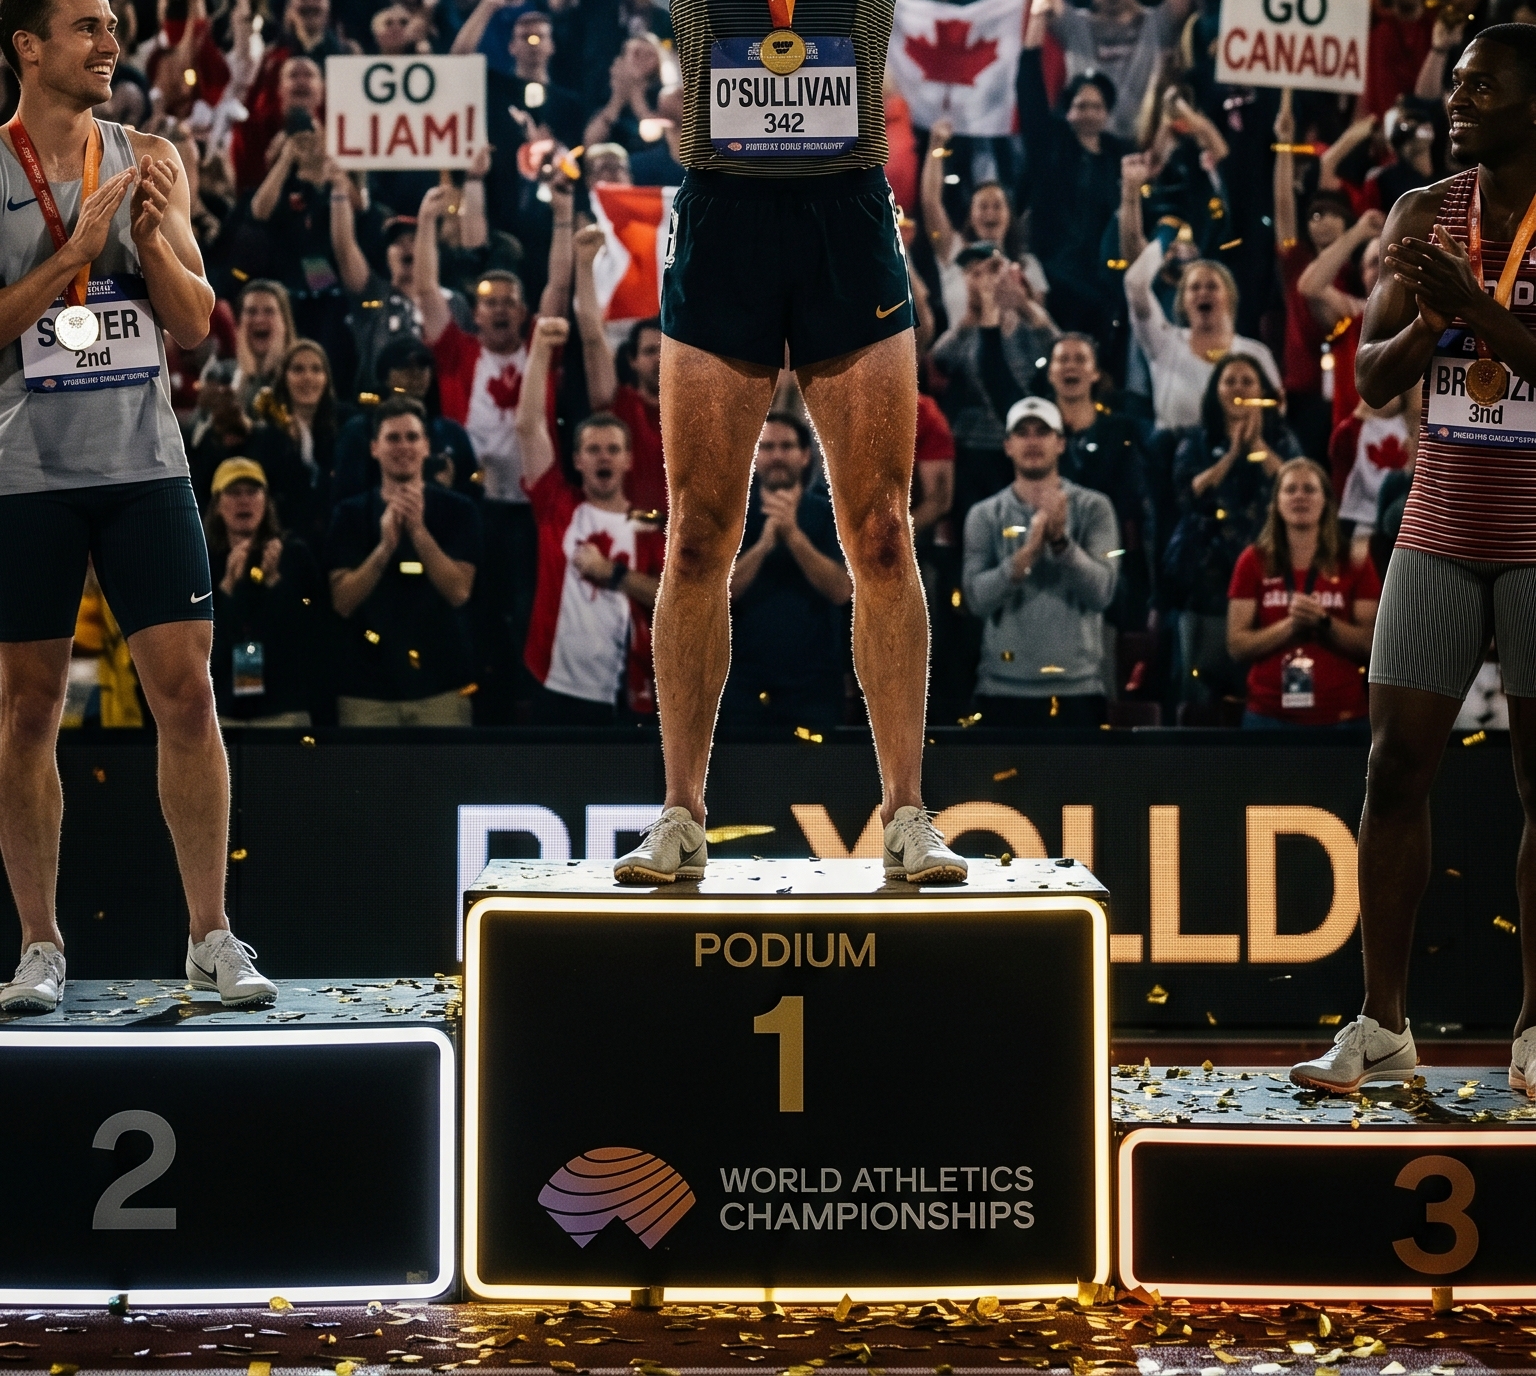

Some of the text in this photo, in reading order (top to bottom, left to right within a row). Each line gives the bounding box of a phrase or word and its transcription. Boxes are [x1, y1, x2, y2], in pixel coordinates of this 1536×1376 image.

[1223, 28, 1361, 79] CANADA
[363, 62, 436, 104] GO
[716, 77, 851, 108] O'SULLIVAN
[337, 105, 475, 157] LIAM!
[764, 113, 805, 133] 342
[75, 347, 112, 368] 2nd
[1468, 403, 1504, 424] 3nd
[695, 932, 876, 968] PODIUM
[753, 996, 804, 1112] 1
[92, 1109, 177, 1230] 2
[720, 1166, 1034, 1193] WORLD ATHLETICS
[720, 1201, 1035, 1231] CHAMPIONSHIPS
[1392, 1155, 1479, 1274] 3
